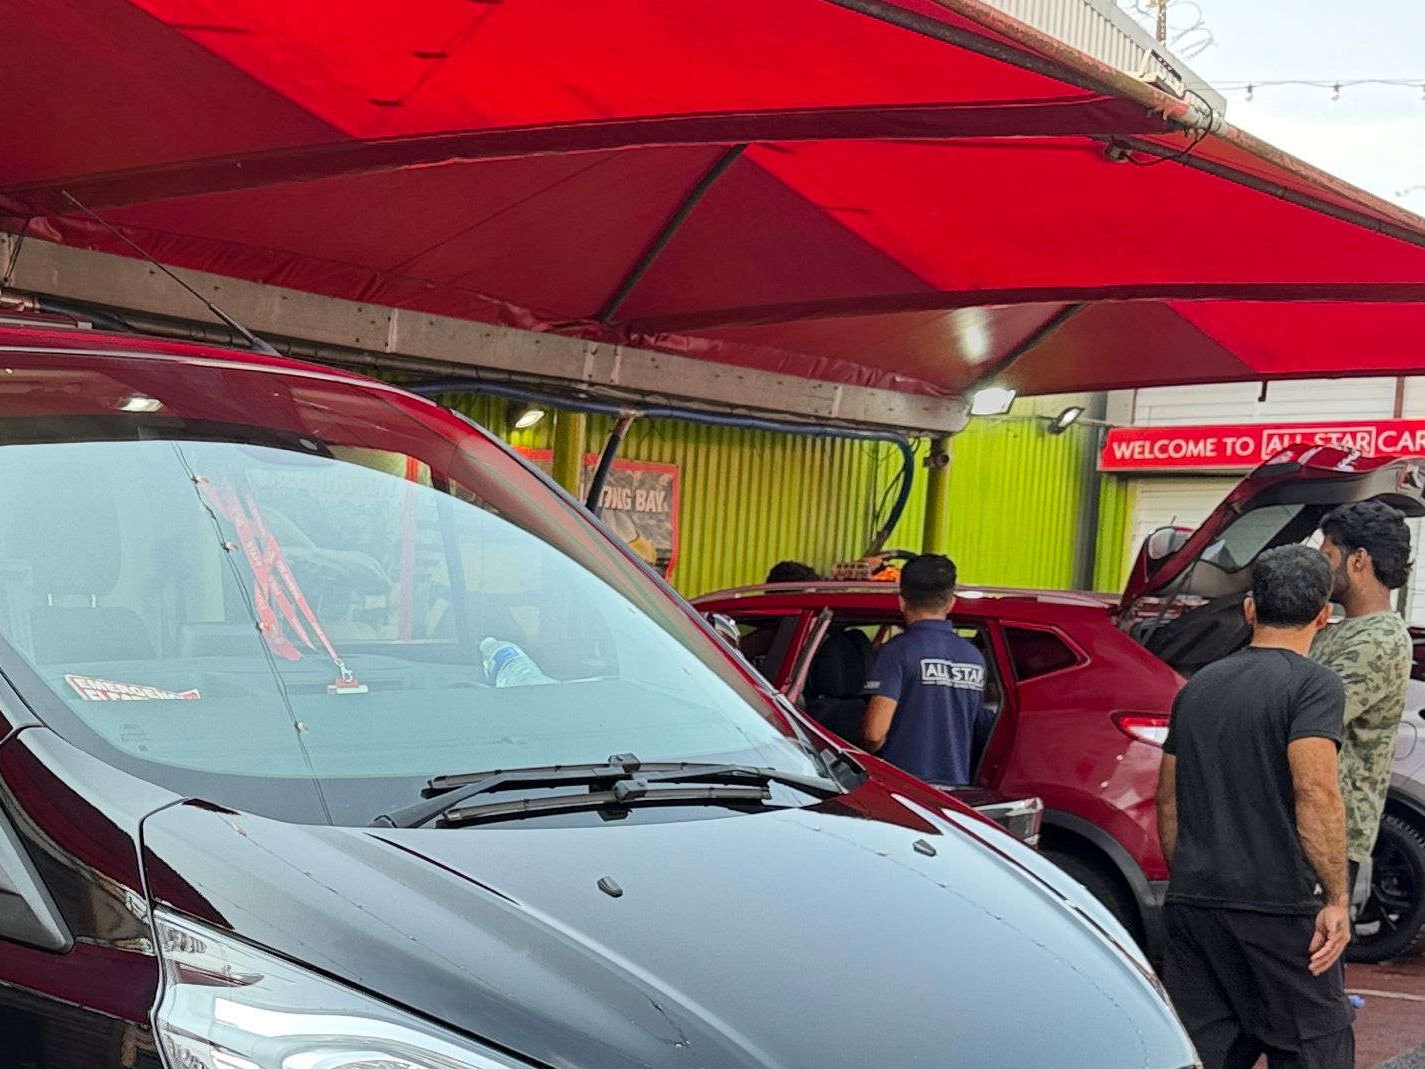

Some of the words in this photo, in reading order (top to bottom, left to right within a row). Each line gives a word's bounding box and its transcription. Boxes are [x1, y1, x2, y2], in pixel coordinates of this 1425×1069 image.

[1112, 437, 1217, 460] WELCOME
[1222, 436, 1255, 457] TO
[1314, 431, 1370, 452] STAR
